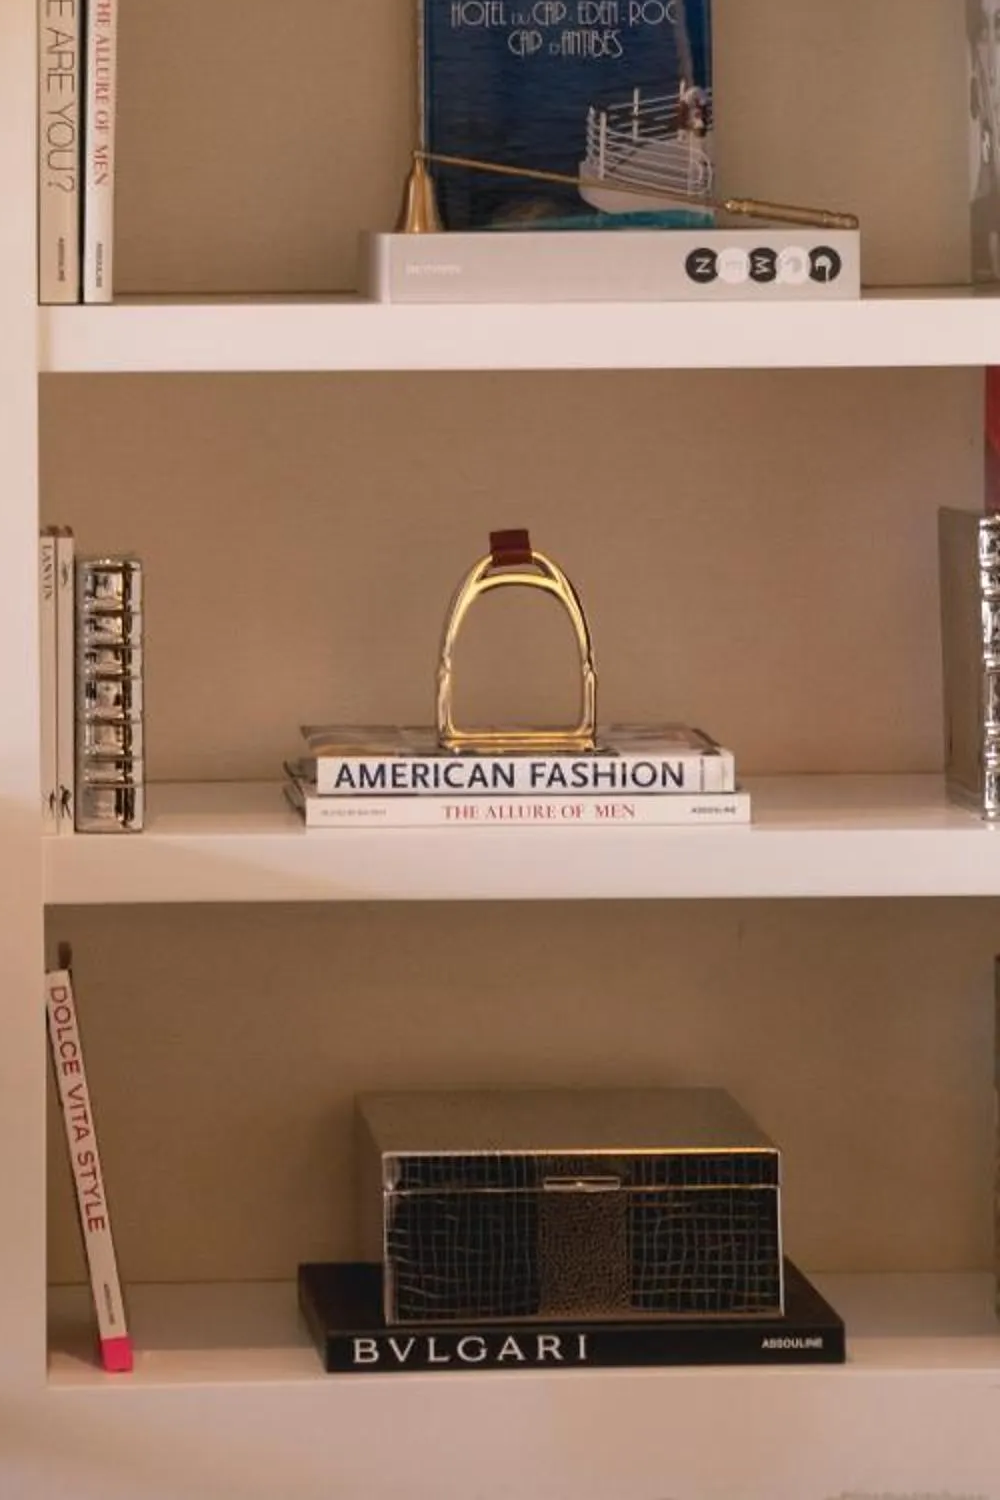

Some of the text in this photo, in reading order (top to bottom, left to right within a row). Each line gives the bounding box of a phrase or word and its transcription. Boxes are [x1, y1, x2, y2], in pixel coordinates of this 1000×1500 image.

[451, 0, 507, 28] HOTEL
[46, 27, 76, 93] ARE
[95, 33, 112, 106] ALLURE
[94, 110, 110, 136] OF
[46, 101, 76, 194] YOU?
[93, 145, 109, 187] MEN
[334, 761, 685, 789] AMERICAN FASHION
[441, 803, 635, 820] THE ALLURE OF MEN
[50, 985, 106, 1233] DOLCE VITA STYLE
[352, 1334, 588, 1364] BVLGARI
